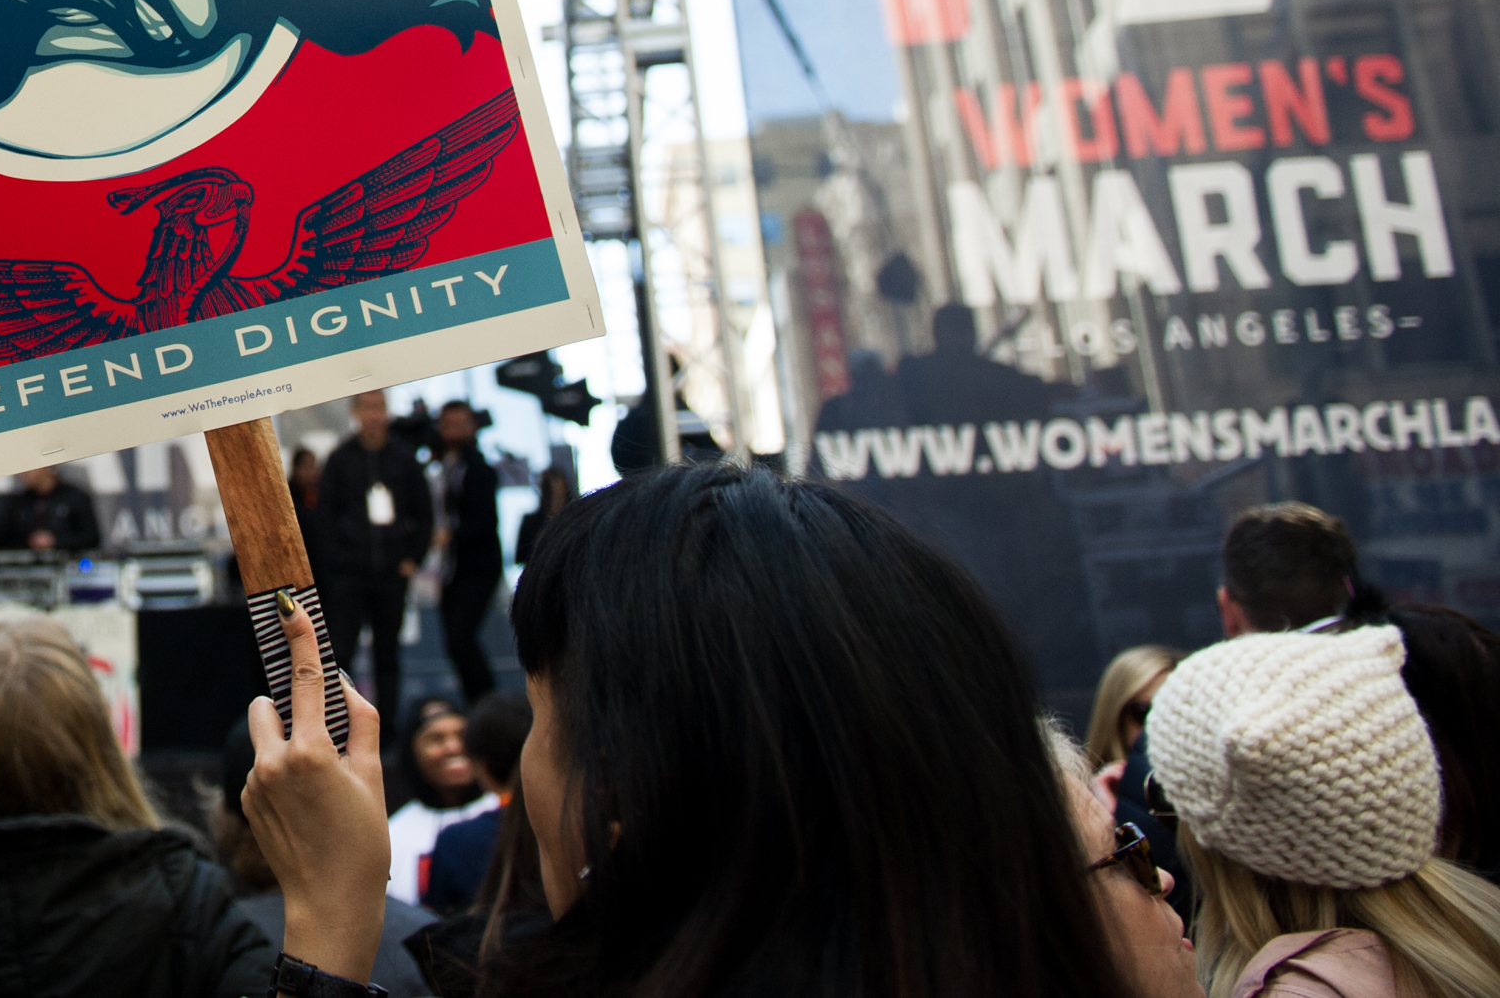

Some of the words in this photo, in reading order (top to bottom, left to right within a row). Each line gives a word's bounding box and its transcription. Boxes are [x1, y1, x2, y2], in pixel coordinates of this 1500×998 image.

[955, 54, 1415, 168] WOMEN'S
[948, 151, 1453, 306] MARCH
[234, 264, 510, 358] DIGNITY
[161, 383, 293, 419] www.WeThePeopleAre.org
[814, 395, 1500, 482] WWW.WOMENSMARCHLA
